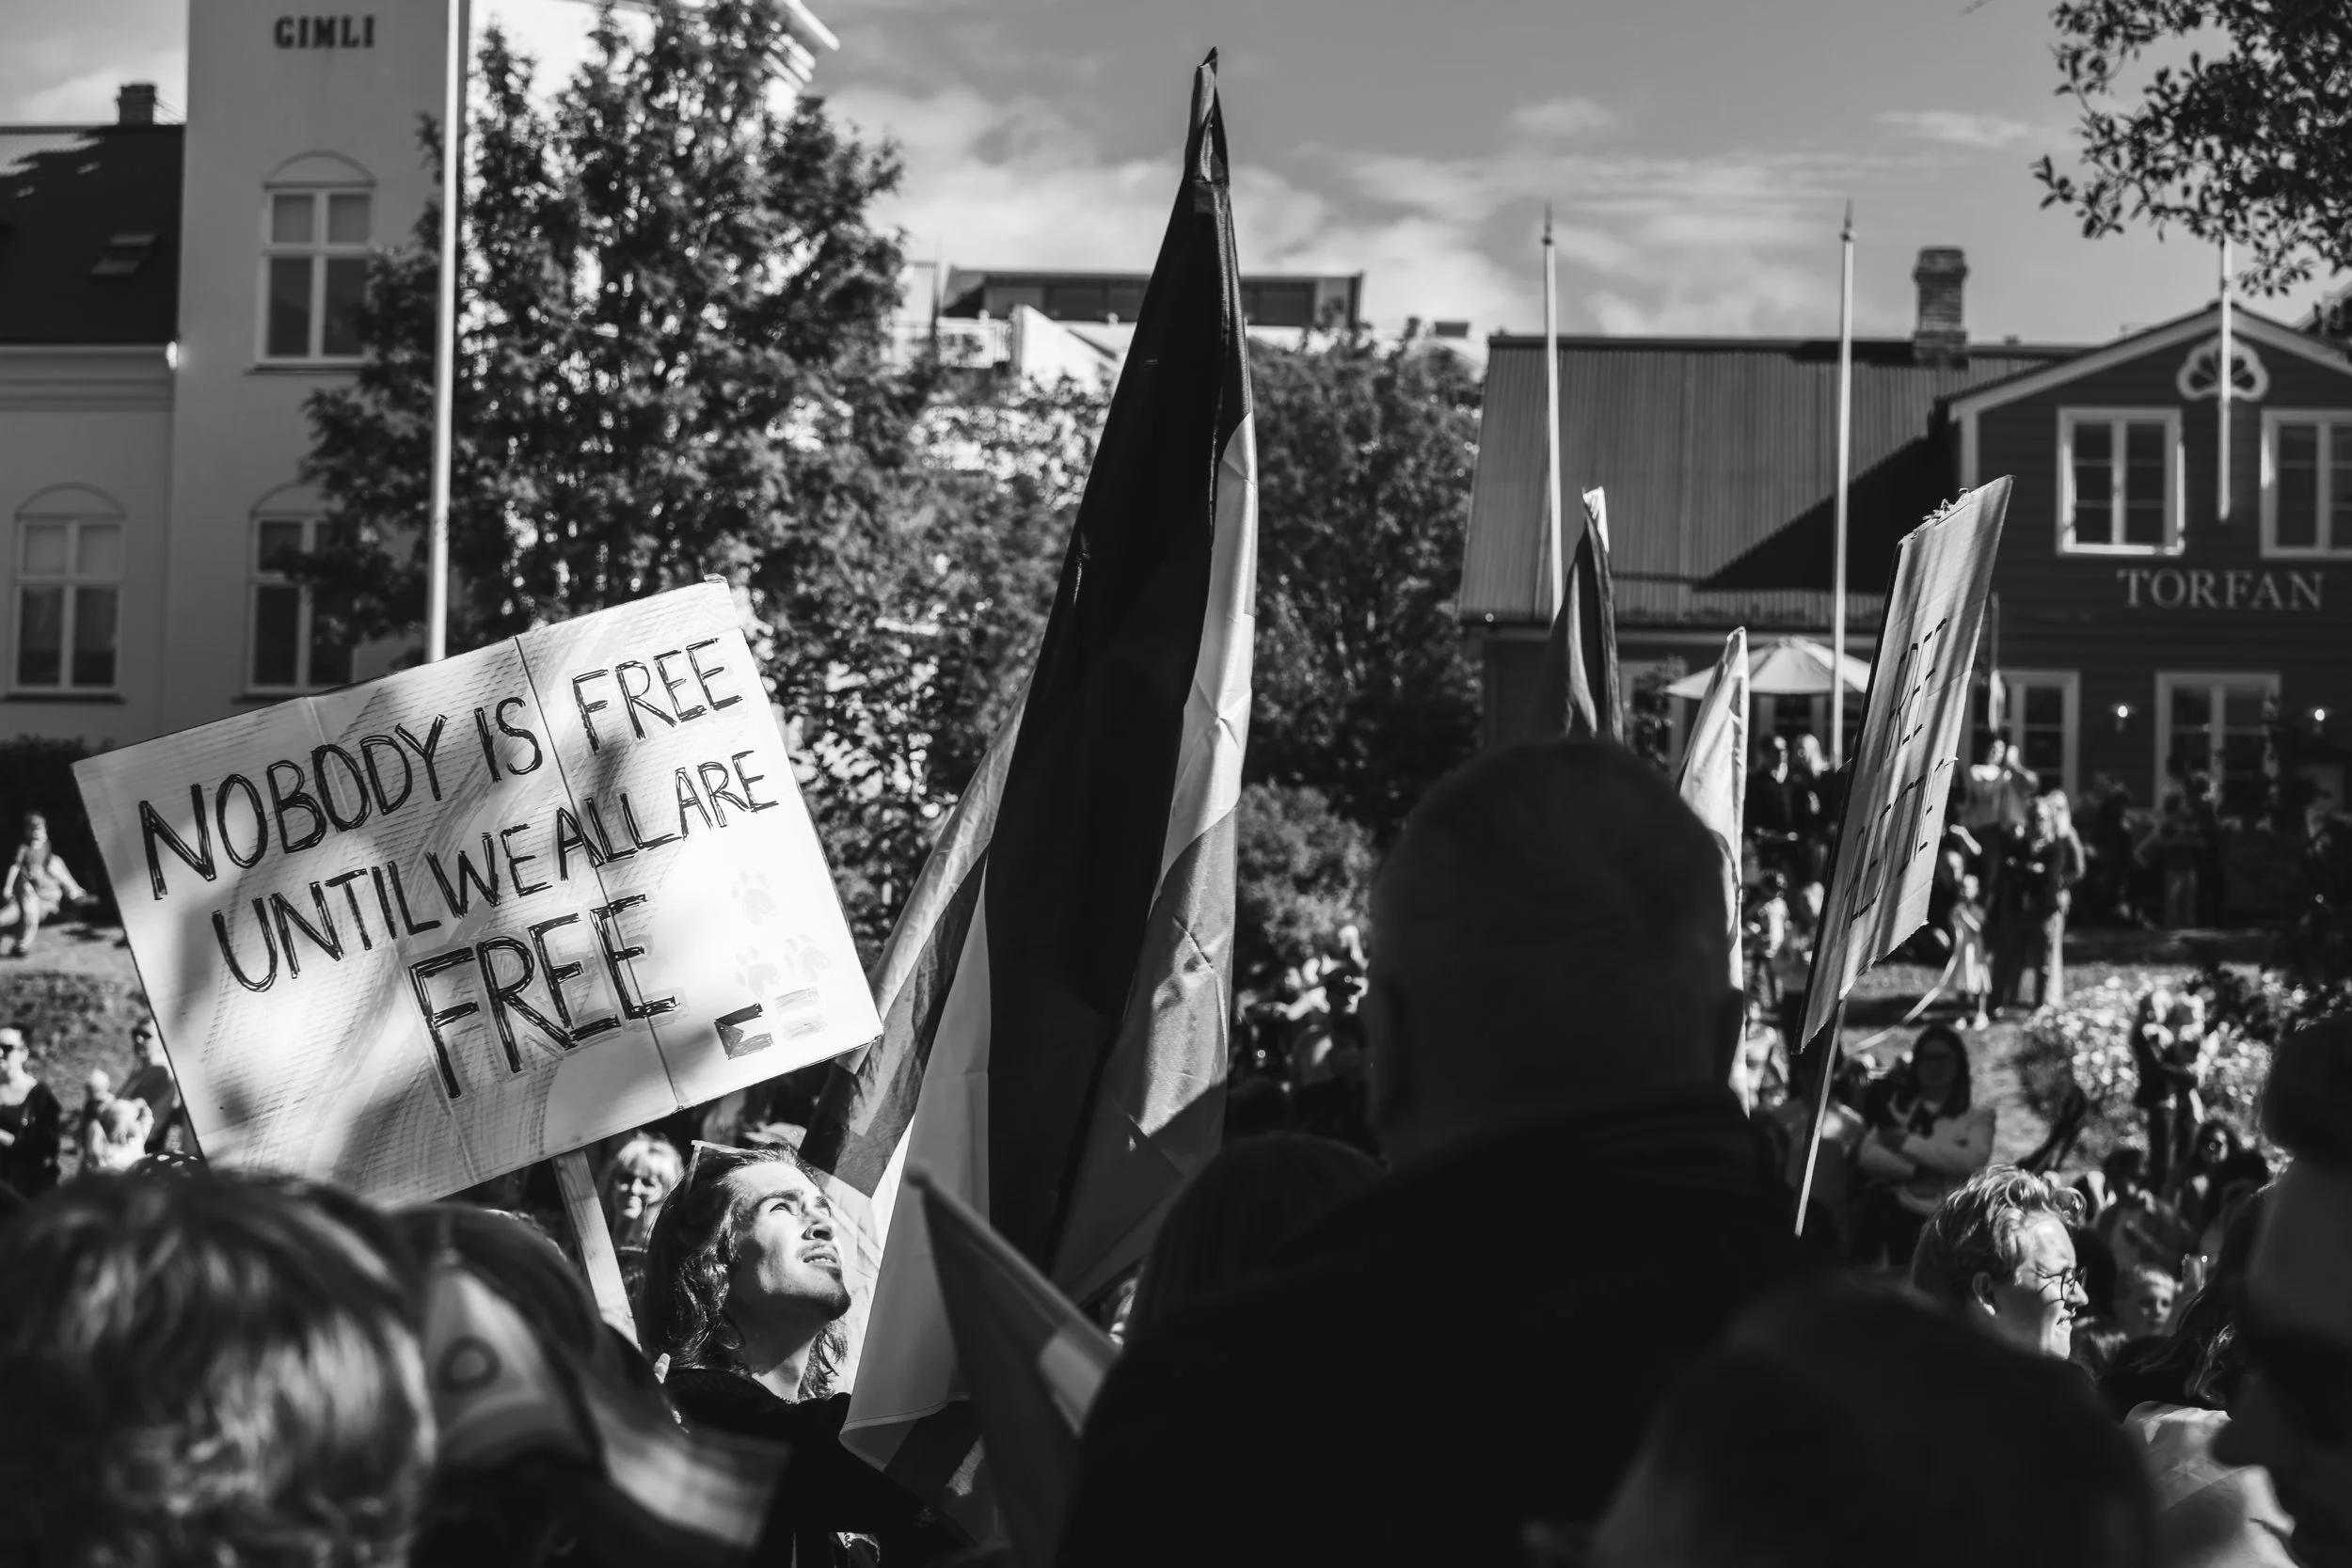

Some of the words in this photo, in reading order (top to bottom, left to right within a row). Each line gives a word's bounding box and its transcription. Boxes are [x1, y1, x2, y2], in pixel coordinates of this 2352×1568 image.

[274, 14, 375, 49] GIMLI
[2117, 568, 2325, 610] TORFAN
[138, 714, 448, 900] NOBODY
[474, 696, 543, 784] IS
[572, 638, 743, 754] FREE
[1877, 618, 1947, 773] FREE
[212, 861, 442, 992] UNTIL
[425, 823, 553, 920] WE
[556, 792, 682, 881] ALL
[675, 750, 780, 841] ARE
[408, 894, 680, 1099] FREE
